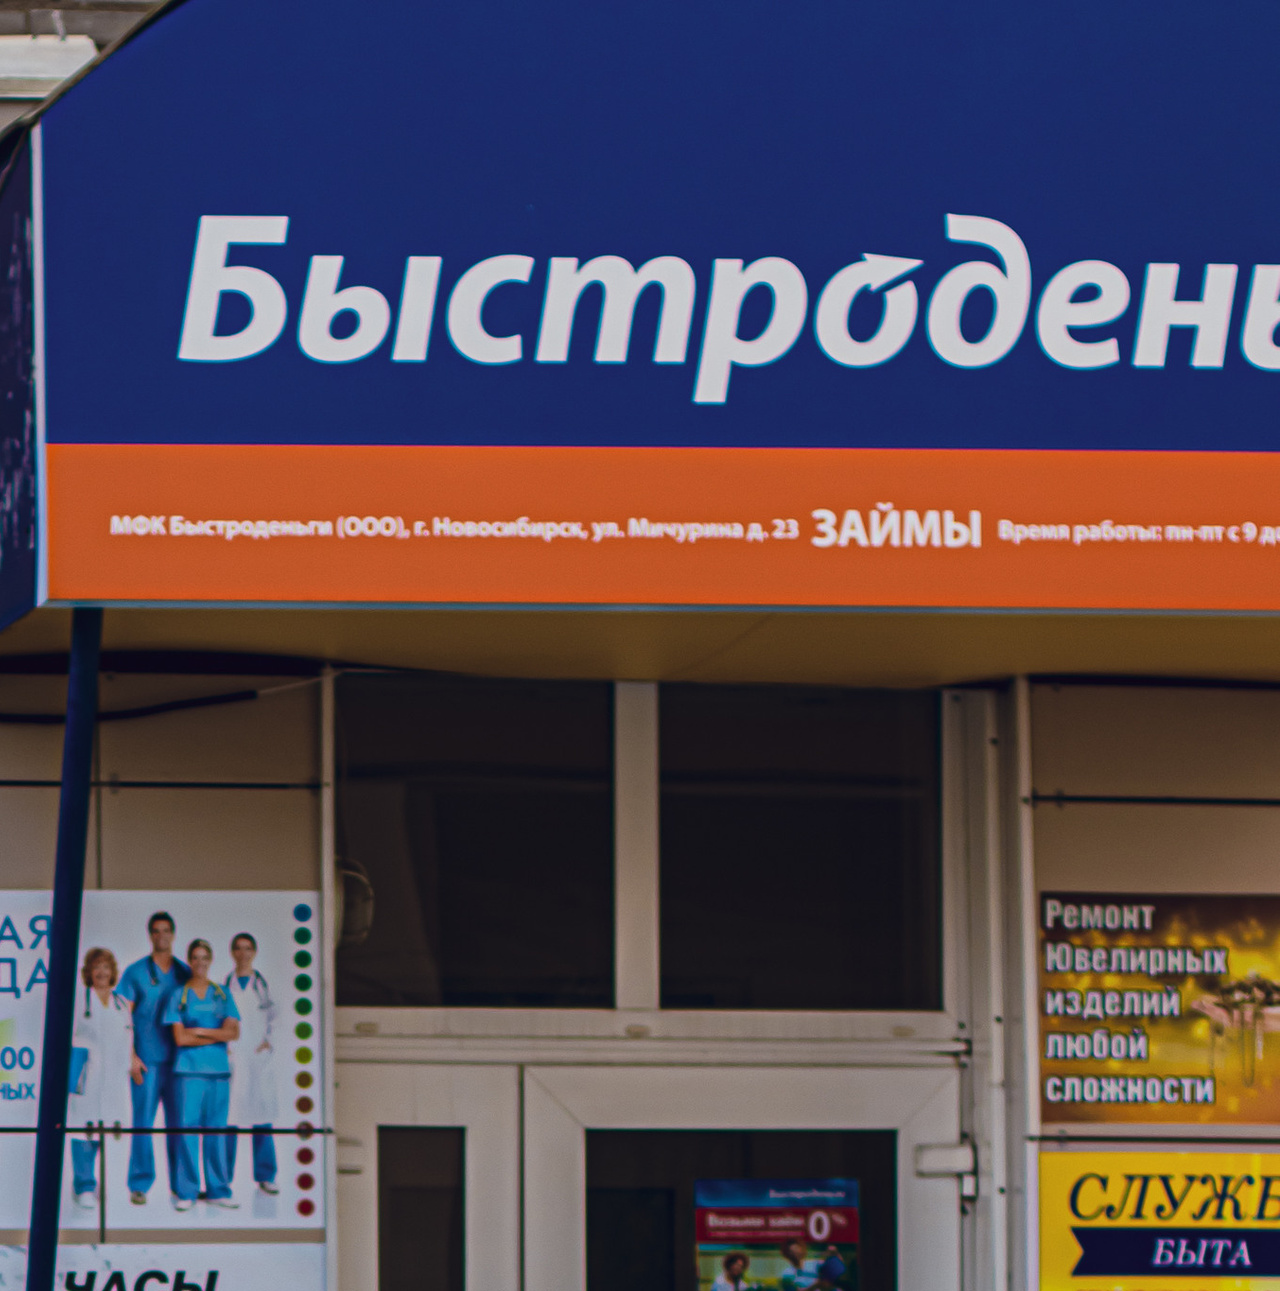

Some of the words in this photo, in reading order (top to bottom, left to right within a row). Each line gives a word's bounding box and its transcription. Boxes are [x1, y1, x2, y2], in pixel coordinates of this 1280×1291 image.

[110, 515, 166, 536] МФК
[170, 516, 333, 541] Быстроденьги
[413, 519, 430, 537] г.
[433, 516, 588, 542] Новосибирск,
[591, 520, 624, 542] ул.
[628, 518, 743, 543] Мичурина
[746, 521, 769, 543] д.
[772, 518, 799, 539] 23
[811, 502, 982, 548] ЗАЙМЫ
[998, 519, 1070, 545] Время
[1226, 525, 1240, 542] с
[1241, 521, 1257, 543] 9
[1045, 899, 1156, 930] Ремонт
[1045, 942, 1229, 977] Ювелирных
[1045, 985, 1180, 1021] изделий
[1045, 1027, 1148, 1059] любой
[1045, 1076, 1215, 1103] сложности
[1152, 1238, 1252, 1267] БЫТА
